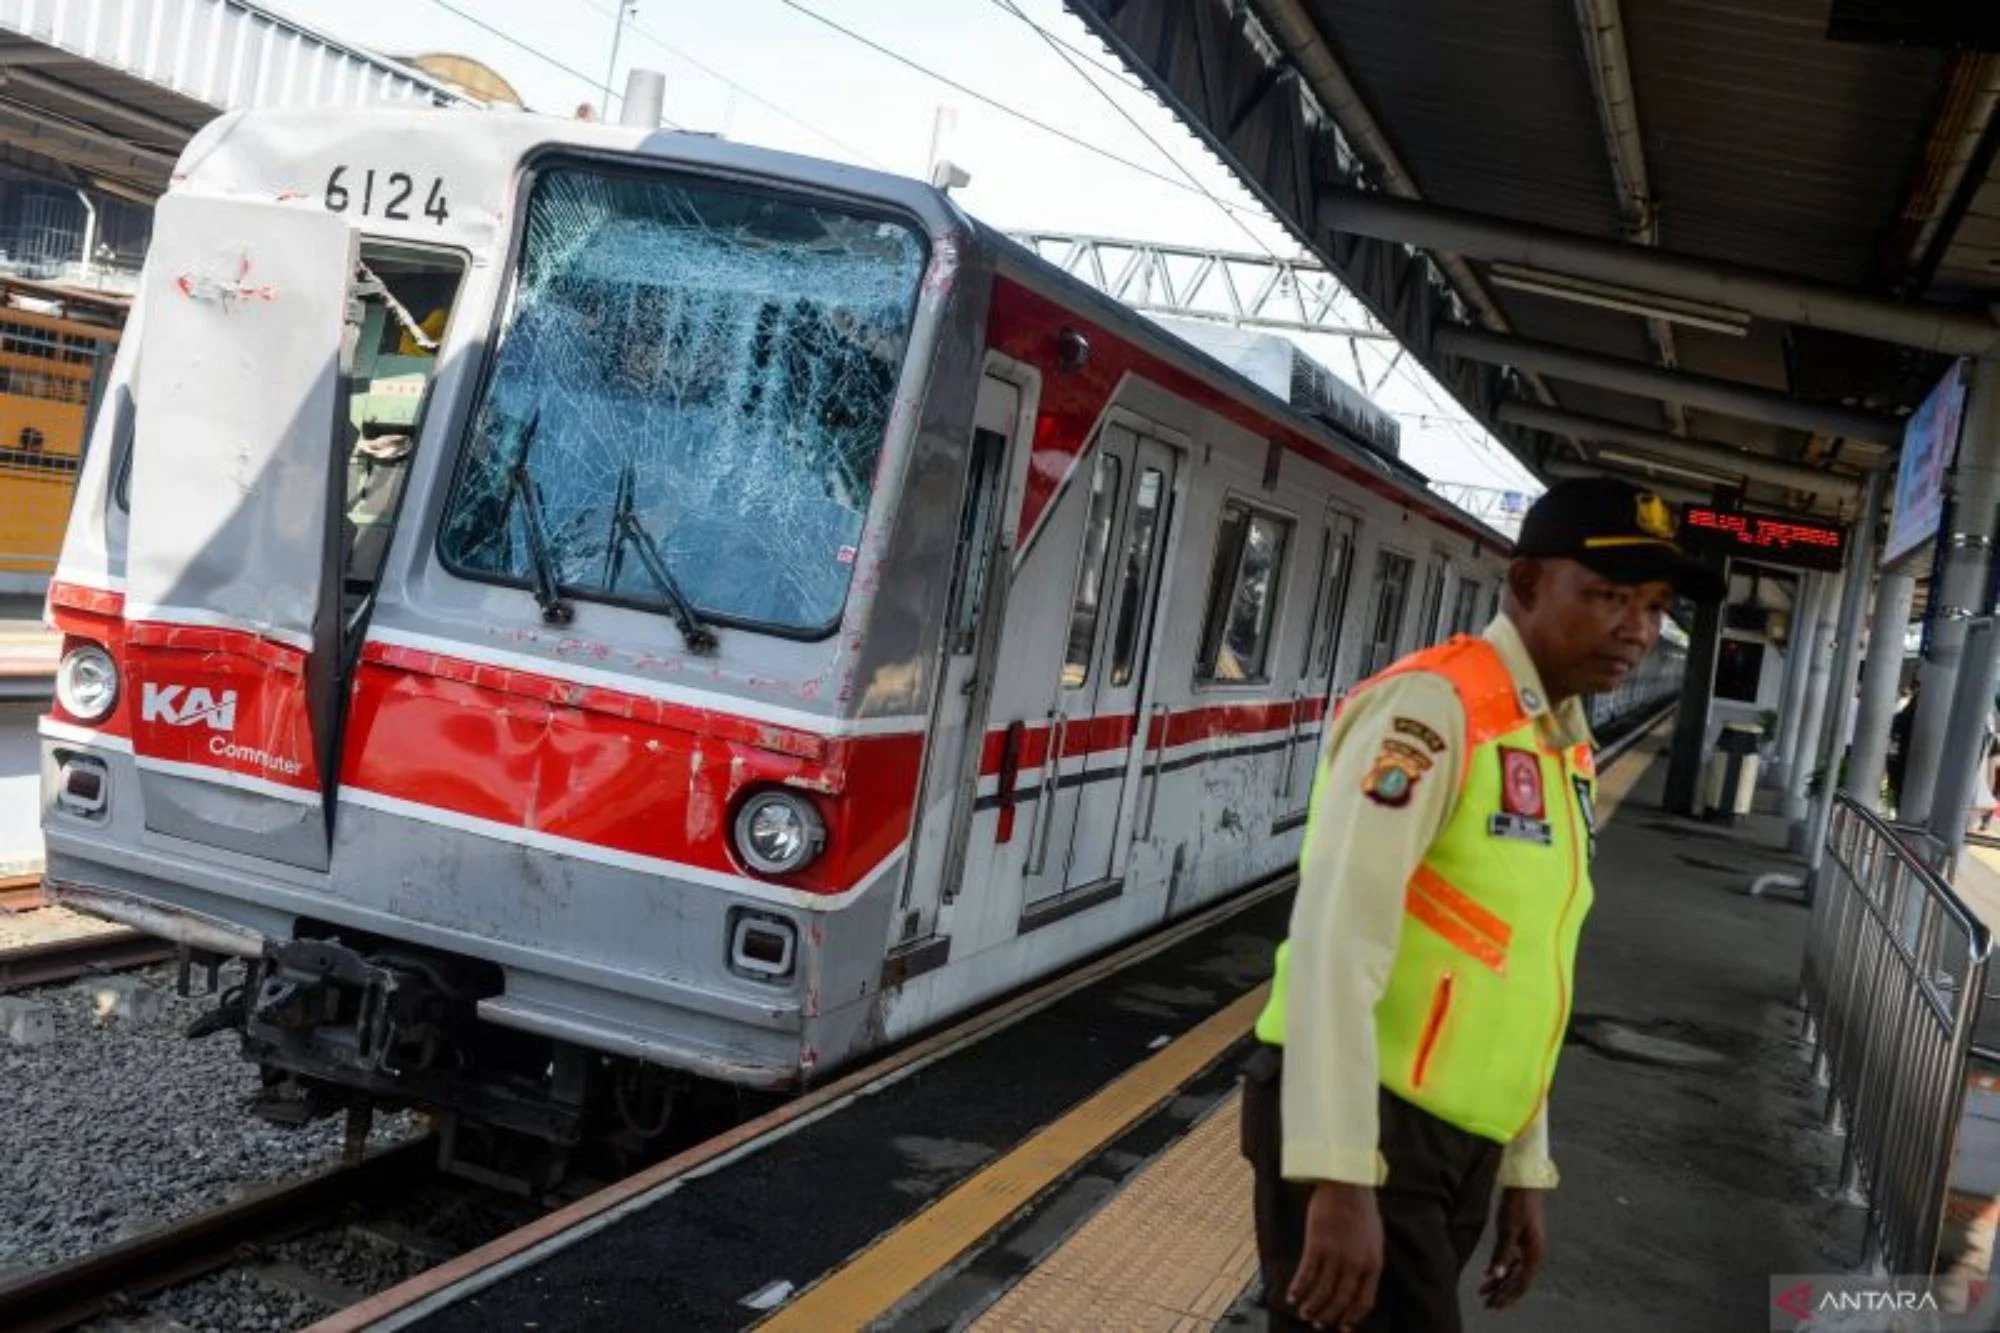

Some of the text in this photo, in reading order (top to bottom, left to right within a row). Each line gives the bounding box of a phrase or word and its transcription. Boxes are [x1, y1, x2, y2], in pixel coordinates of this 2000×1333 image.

[325, 164, 449, 226] 6124
[141, 681, 238, 732] KAI
[208, 735, 303, 776] Commuter
